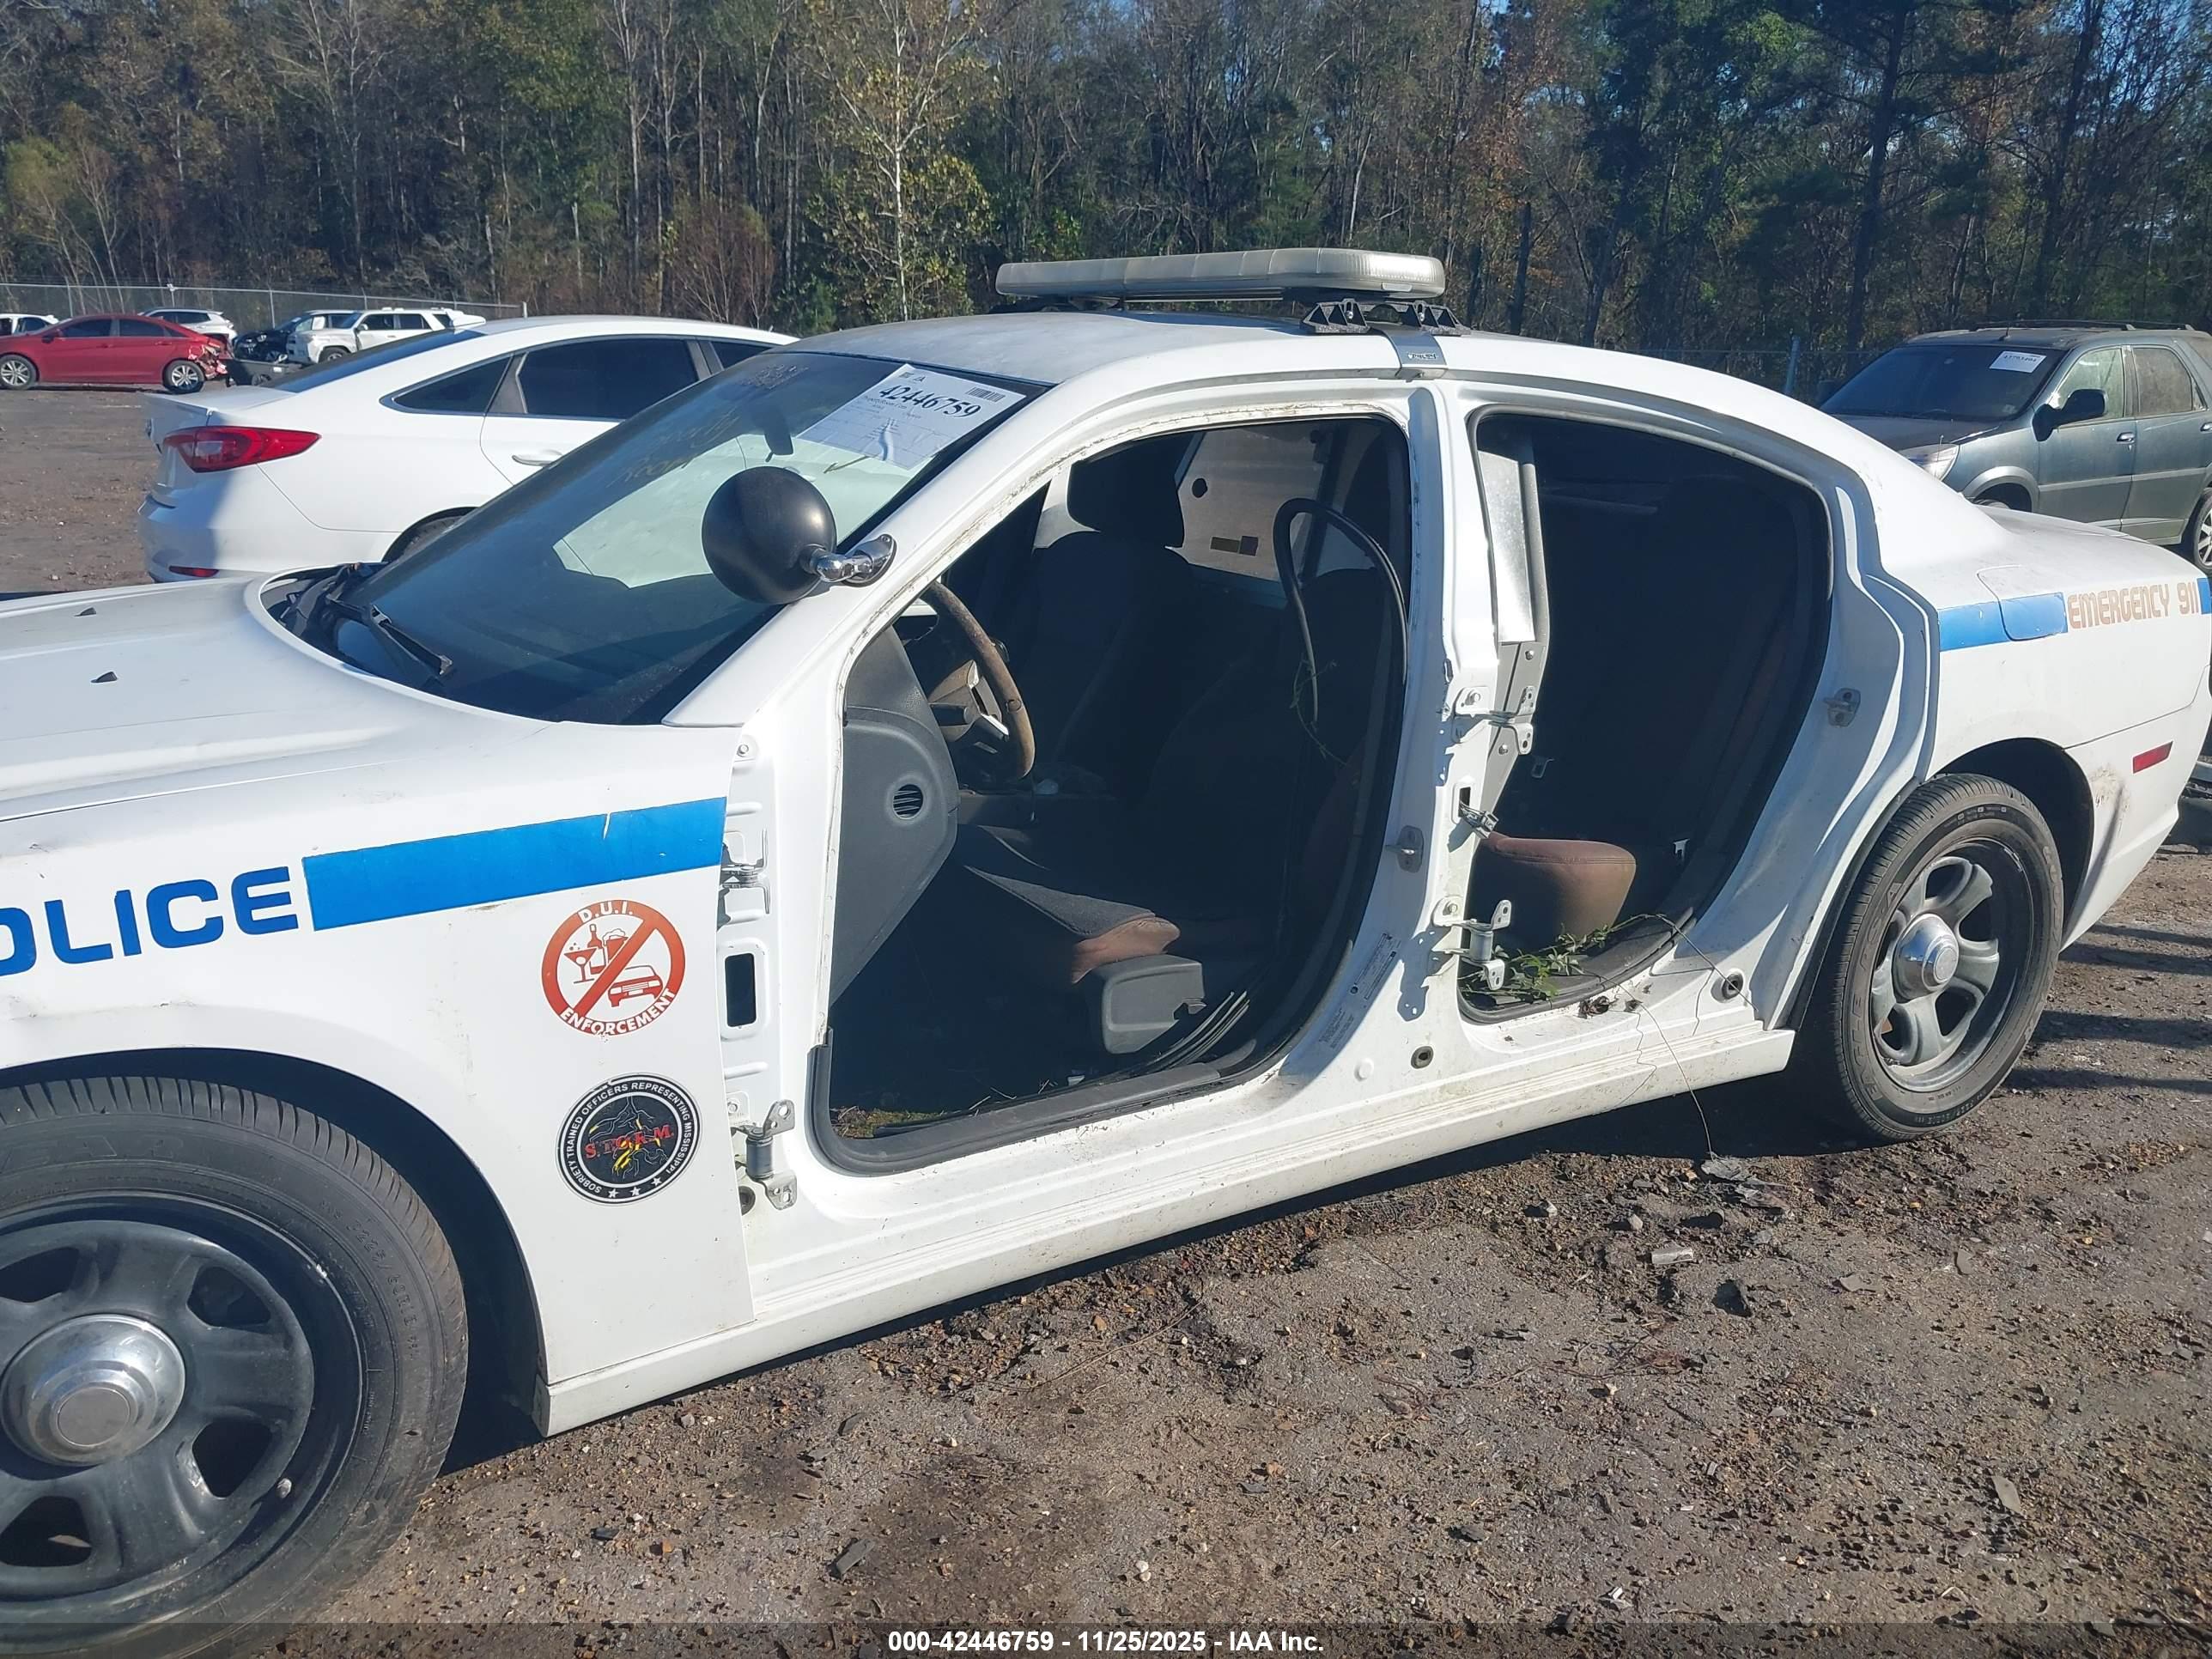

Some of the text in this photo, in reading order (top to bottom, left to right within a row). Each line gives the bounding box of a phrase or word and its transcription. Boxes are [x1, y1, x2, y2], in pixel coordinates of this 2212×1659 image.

[878, 385, 981, 417] 42446759
[2068, 581, 2199, 629] EMERGENCY 911
[578, 901, 634, 923] D.U.I.
[560, 988, 677, 1036] ENFORCEMENT
[566, 1081, 693, 1194] SOBRIETY TRAINED OFFICERS REPRESENTING MISSISSIPPI
